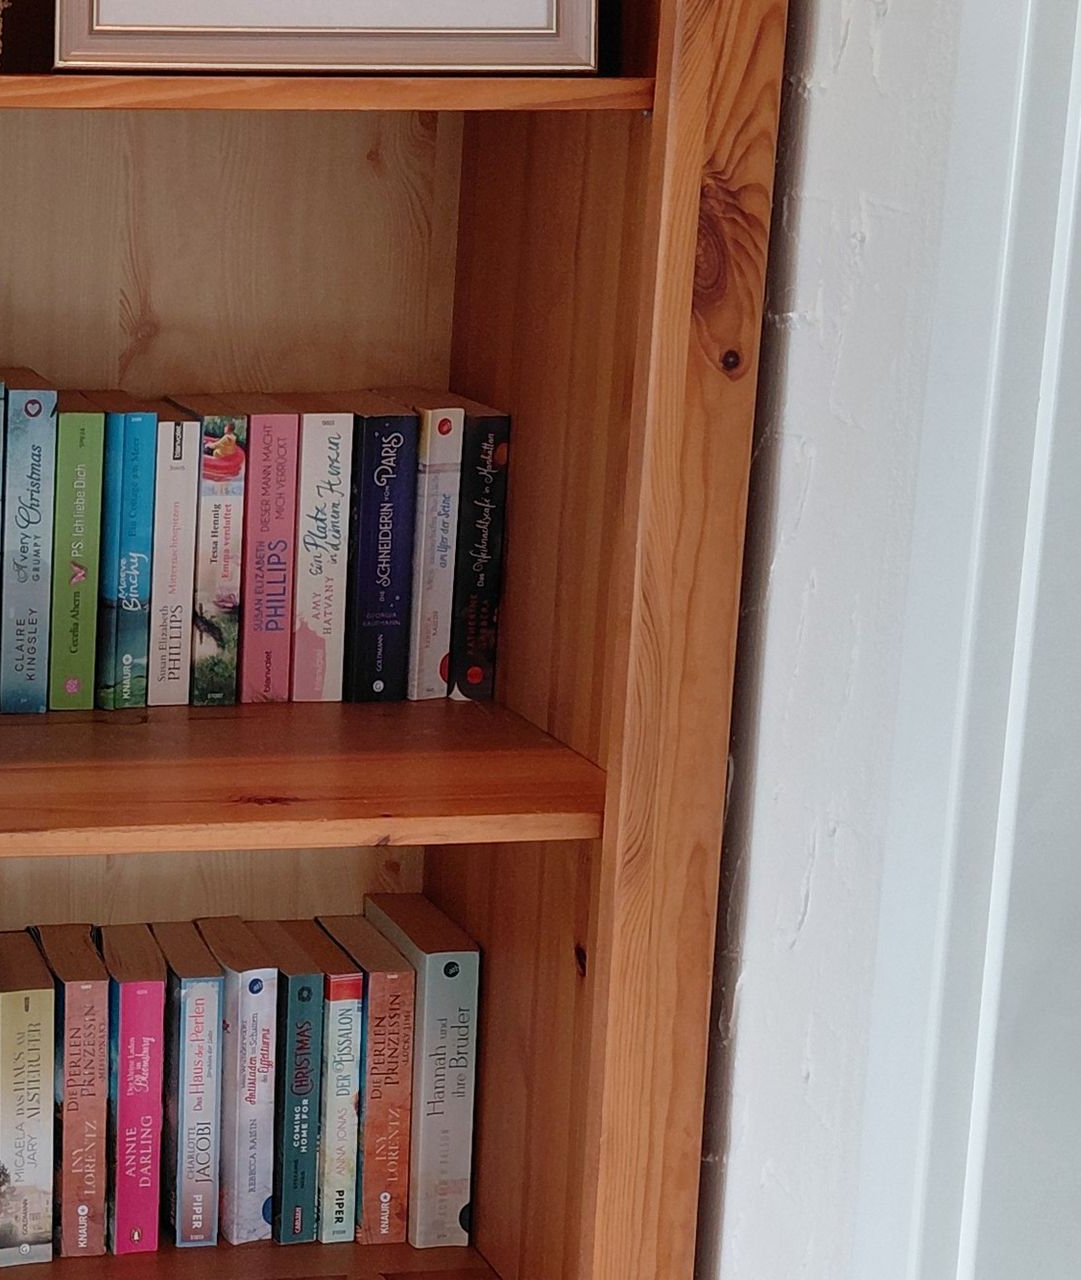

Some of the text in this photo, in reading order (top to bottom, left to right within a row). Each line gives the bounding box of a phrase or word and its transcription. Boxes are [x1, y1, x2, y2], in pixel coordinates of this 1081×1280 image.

[74, 463, 86, 489] Dich
[260, 425, 273, 532] DIESER MANN MACHT
[316, 432, 345, 498] Herzen
[15, 444, 42, 581] GRUMPY Christmas
[72, 520, 86, 537] Ich
[74, 491, 86, 516] liebe
[275, 493, 285, 519] MICH
[325, 502, 341, 552] deinem
[374, 432, 404, 587] SCHNEIDERIN PARIS
[20, 532, 32, 557] very
[210, 503, 221, 564] Tessa Hennig
[222, 504, 232, 579] Emma verduftet
[303, 502, 330, 576] Ein Platz
[328, 553, 338, 565] in
[119, 558, 128, 599] Maeve
[122, 552, 149, 611] Binchy
[254, 540, 265, 632] SUSAN ELIZABETH
[265, 539, 287, 632] PHILLIPS
[312, 592, 322, 620] AMY
[323, 576, 334, 634] HATVANY
[476, 573, 485, 587] Das
[15, 619, 26, 671] CLAIRE
[27, 608, 38, 681] KINGSLEY
[158, 606, 169, 682] Susan Elizabeth
[168, 604, 183, 680] PHILLIPS
[122, 664, 131, 699] KNAUR
[264, 651, 272, 693] blanvalet
[189, 998, 205, 1041] Perlen
[385, 993, 401, 1085] PRINZESSIN
[67, 1027, 81, 1112] DIE PERLEN
[81, 1005, 96, 1097] PRINZESSIN
[189, 1059, 204, 1094] Haus
[291, 1020, 314, 1096] CHRISTMAS
[332, 1008, 354, 1097] DER EISSALON
[371, 1016, 387, 1100] DIE PERLEN
[427, 1045, 446, 1116] Hannah
[437, 1018, 448, 1039] und
[193, 1096, 202, 1111] Das
[451, 1073, 466, 1098] ihre
[15, 1122, 26, 1182] MICAELA
[27, 1135, 38, 1167] JARY
[125, 1127, 137, 1177] ANNIE
[139, 1115, 153, 1187] DARLING
[187, 1127, 195, 1179] CHARLOTTE
[195, 1122, 214, 1183] JACOBI
[293, 1105, 301, 1147] COMING
[336, 1107, 347, 1176] ANNA JONAS
[376, 1136, 387, 1160] INY
[387, 1108, 401, 1182] LORENTZ
[72, 1148, 83, 1173] INY
[84, 1120, 97, 1195] LORENTZ
[248, 1119, 257, 1193] REBECCA RAISIN
[78, 1216, 88, 1248] KNAUR
[192, 1195, 202, 1229] PIPER
[334, 1190, 345, 1224] PIPER
[380, 1202, 390, 1234] KNAUR
